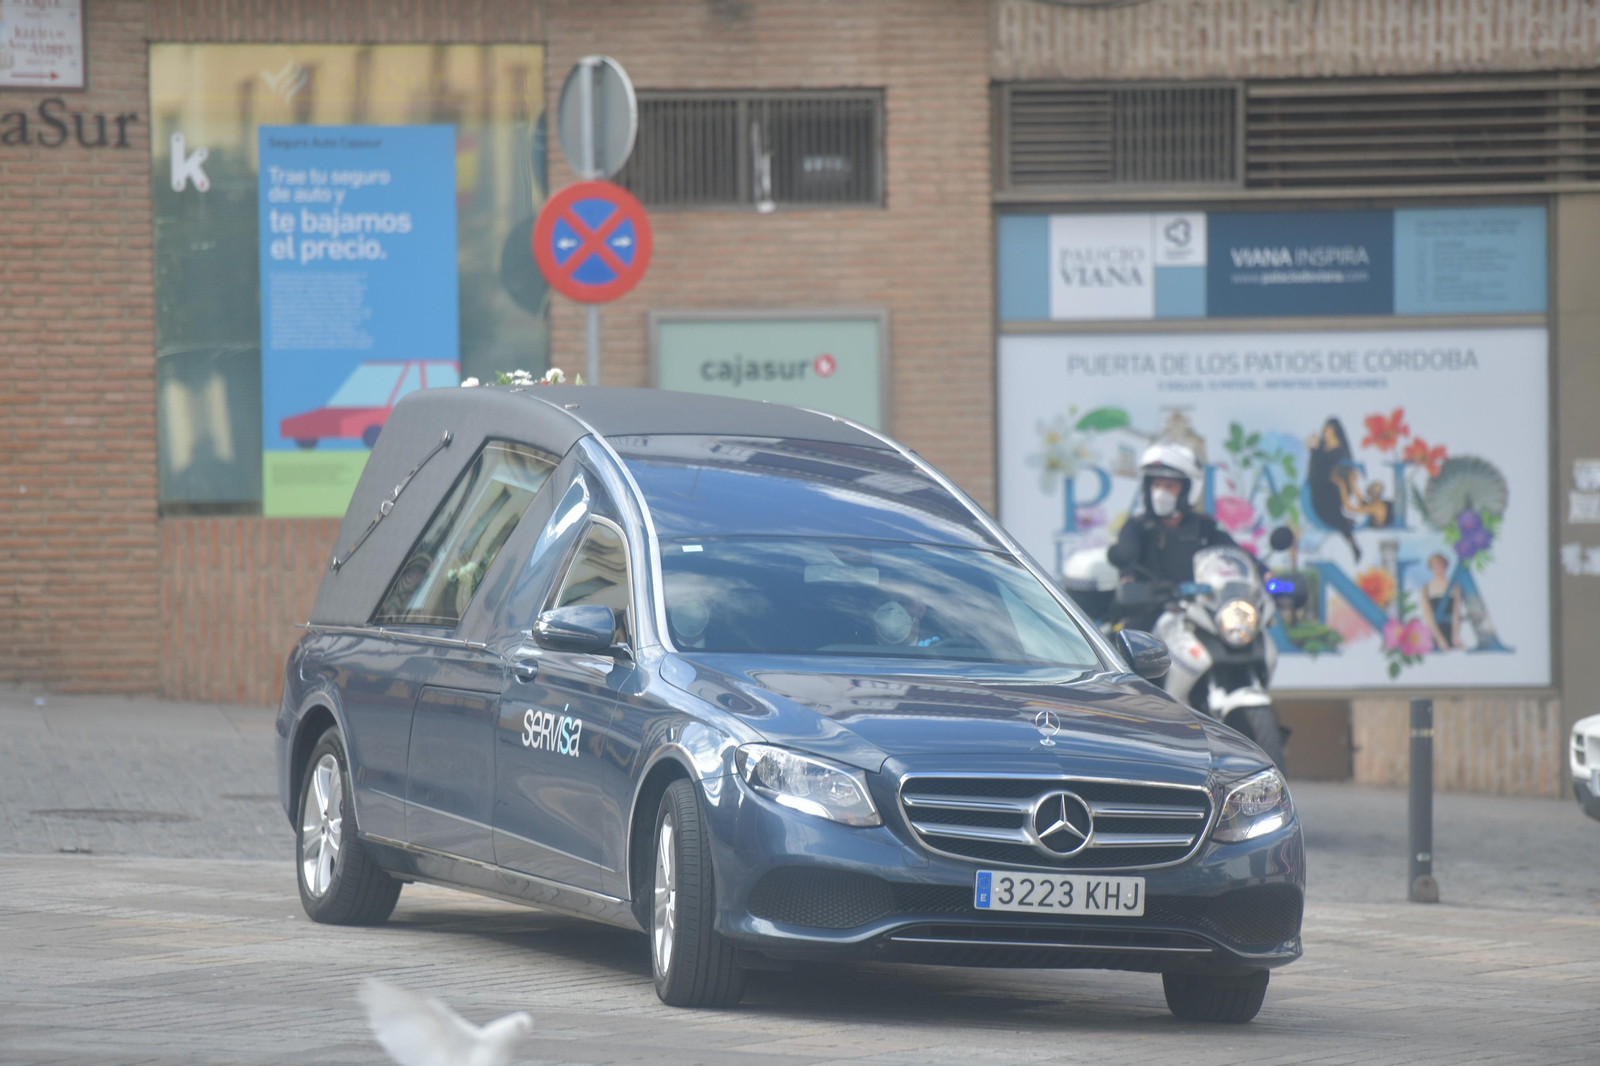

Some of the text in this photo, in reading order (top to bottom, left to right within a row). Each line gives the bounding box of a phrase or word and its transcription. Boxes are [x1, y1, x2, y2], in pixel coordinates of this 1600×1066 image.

[0, 98, 138, 148] aSur
[171, 131, 210, 192] k
[269, 166, 391, 188] Trae tu seguro
[268, 185, 347, 206] de auto y
[269, 206, 412, 238] te bajamos
[271, 235, 387, 265] el precio.
[1229, 245, 1371, 267] VIANA INSPIRA
[1060, 266, 1145, 288] VIANA
[699, 353, 809, 388] cajasur
[1067, 352, 1156, 377] PUERTA
[1159, 352, 1191, 376] DE
[1195, 351, 1240, 375] LOS
[1244, 350, 1323, 375] PATIOS
[1328, 349, 1358, 373] DE
[980, 877, 1139, 910] E 3223 KHJ
